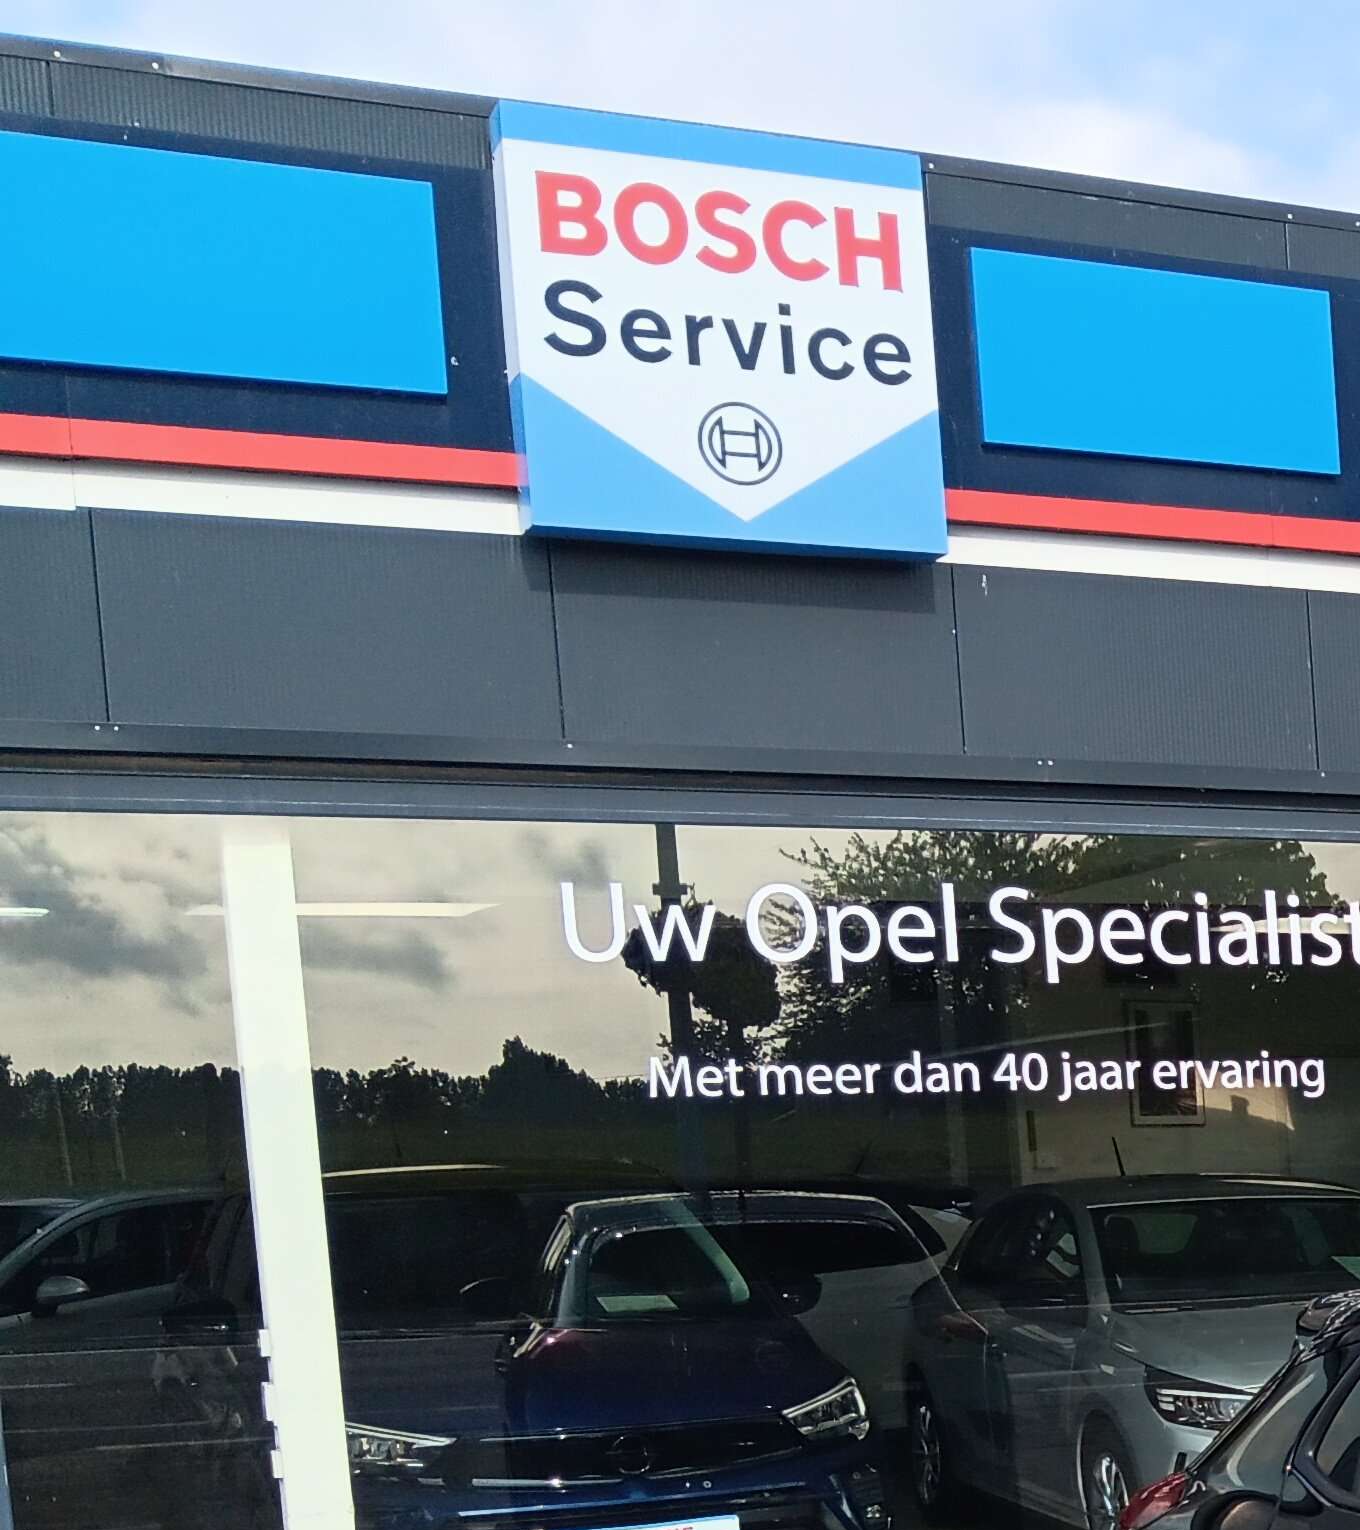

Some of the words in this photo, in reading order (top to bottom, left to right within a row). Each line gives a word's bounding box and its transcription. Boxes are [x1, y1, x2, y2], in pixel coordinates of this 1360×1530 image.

[535, 170, 903, 293] BOSCH
[543, 279, 913, 386] Service
[560, 881, 717, 963] Uw
[745, 882, 959, 983] Opel
[648, 1053, 745, 1099] Met
[758, 1063, 878, 1097] meer
[893, 1050, 981, 1094] dan
[993, 1052, 1049, 1092] 40
[1058, 1051, 1142, 1102] jaar
[1152, 1050, 1325, 1098] ervaring
